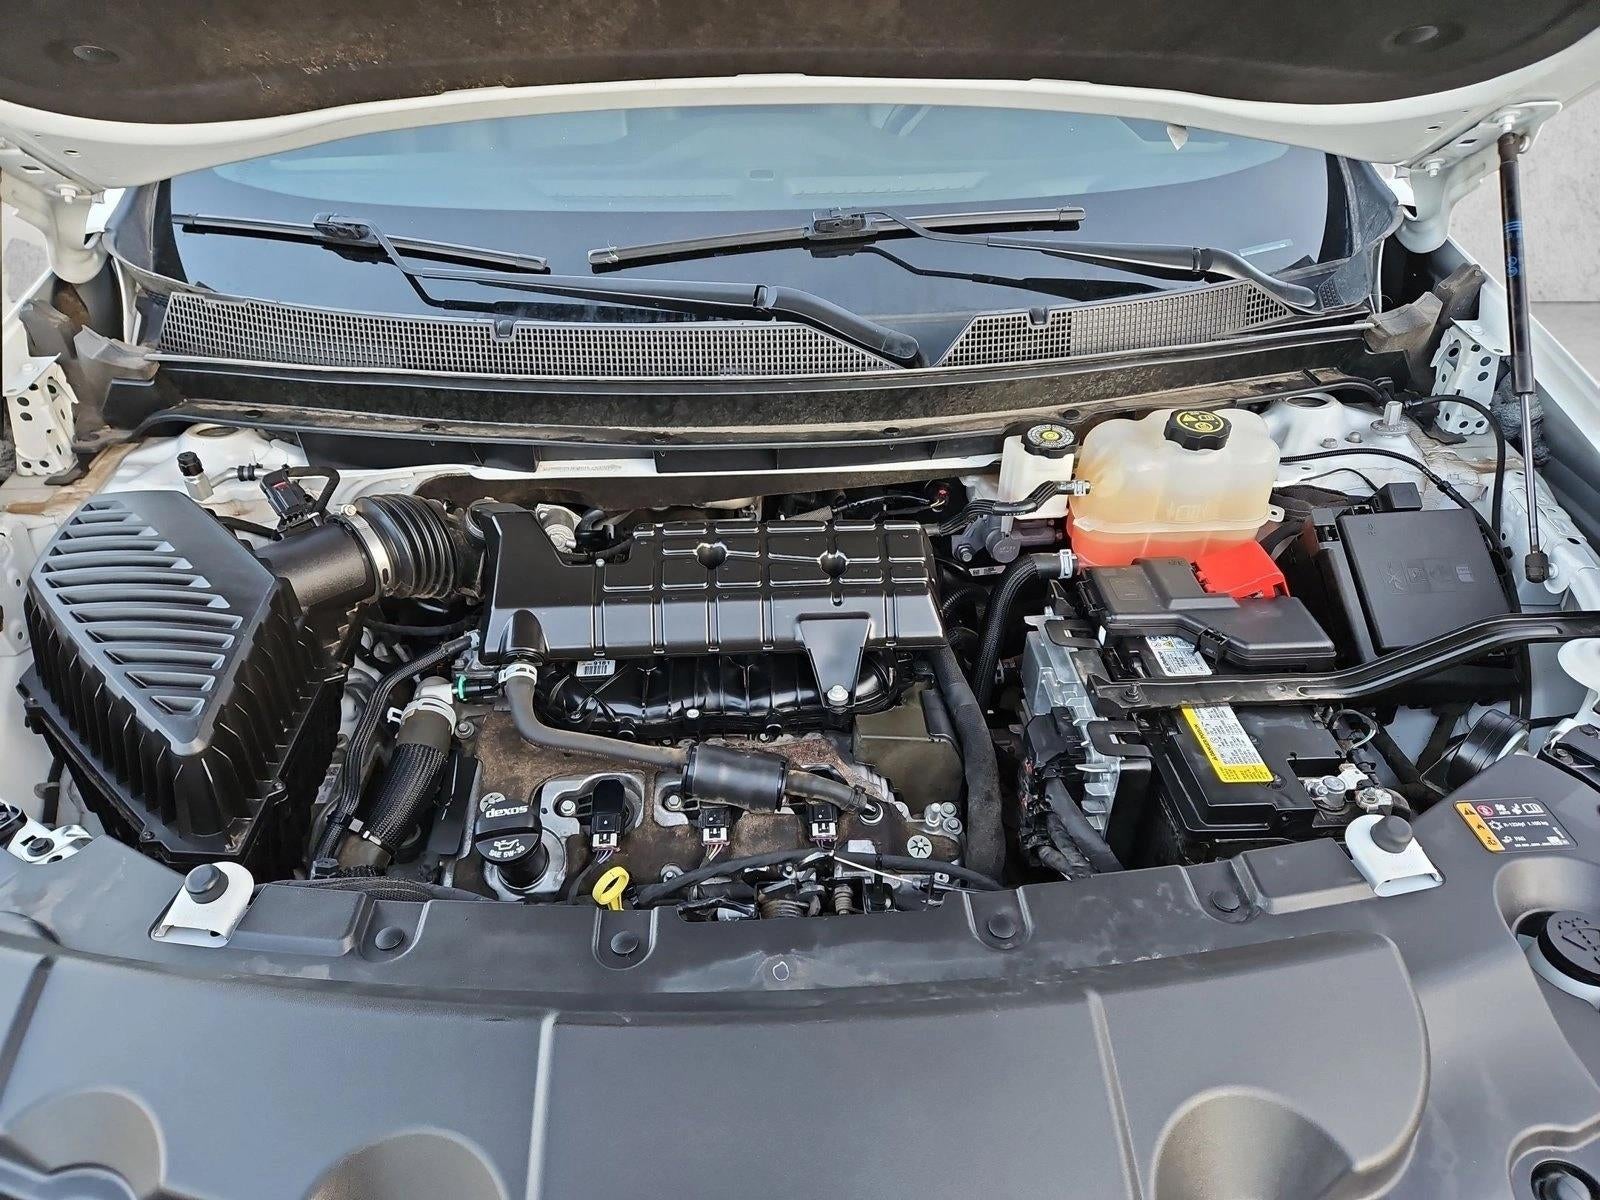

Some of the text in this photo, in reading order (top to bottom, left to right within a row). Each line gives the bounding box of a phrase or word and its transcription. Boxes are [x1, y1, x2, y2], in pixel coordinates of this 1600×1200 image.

[485, 805, 529, 818] dexos
[489, 845, 525, 858] SAE 5W-30
